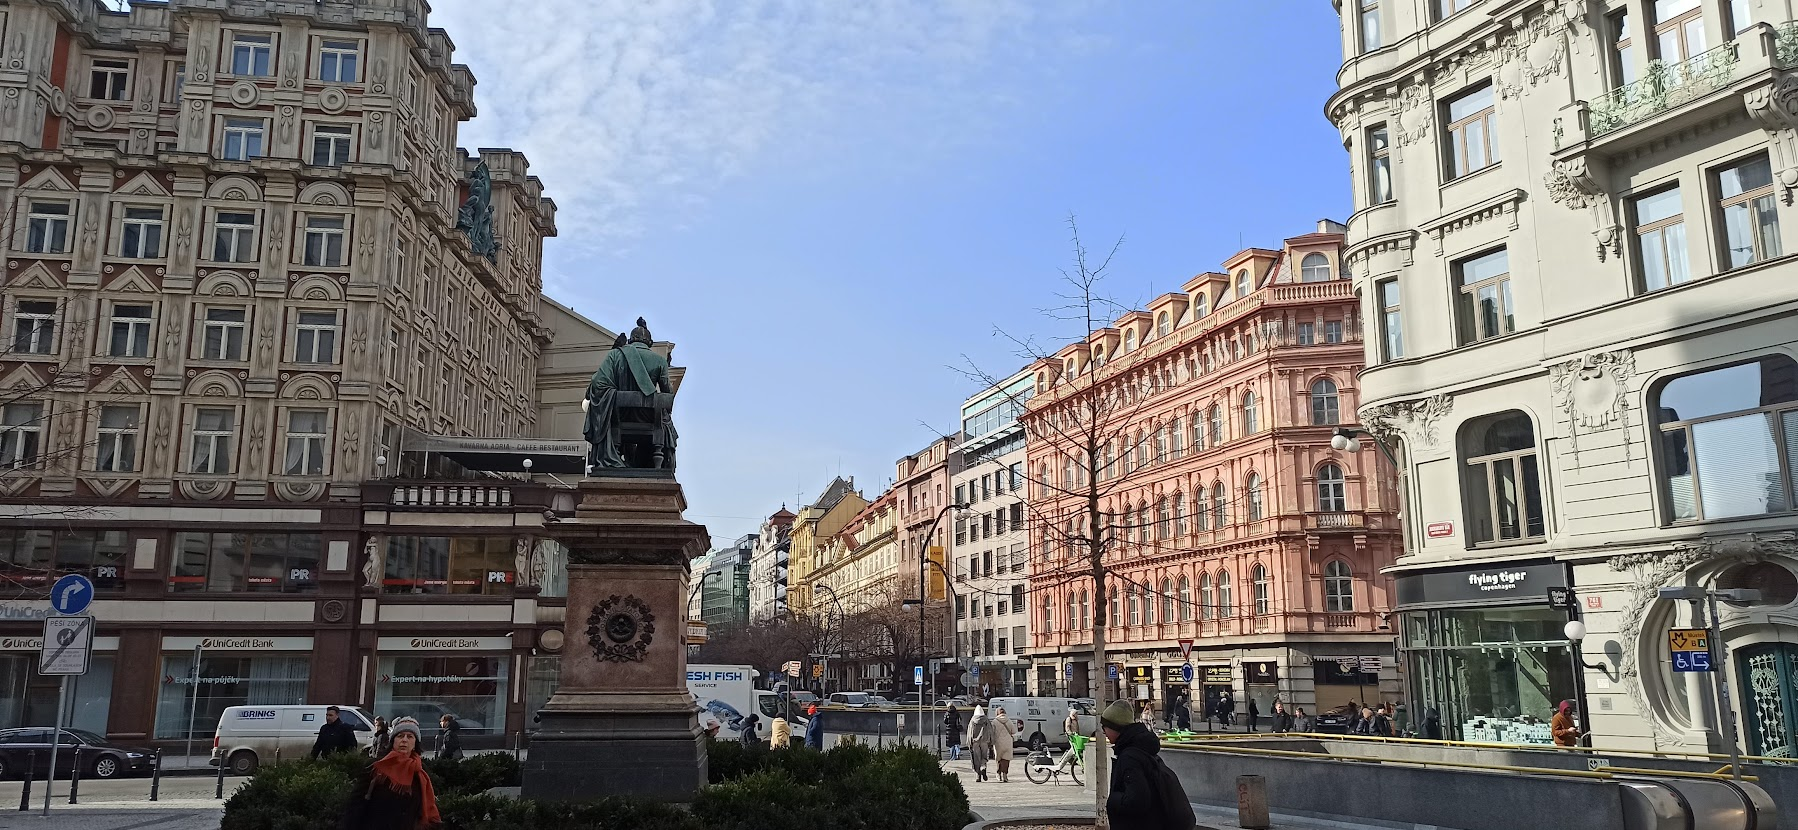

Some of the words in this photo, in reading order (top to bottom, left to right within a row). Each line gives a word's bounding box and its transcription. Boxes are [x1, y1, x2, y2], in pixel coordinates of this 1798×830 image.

[481, 291, 501, 317] ADRIA
[97, 566, 117, 578] PR
[488, 571, 513, 583] PRE
[1468, 573, 1499, 586] flying
[1499, 571, 1526, 584] tiger
[13, 639, 42, 648] UniCre
[213, 639, 250, 648] UniCredit
[252, 639, 274, 648] Bank
[421, 639, 457, 648] UniCredit
[459, 639, 479, 648] Bank
[175, 676, 200, 685] Expet
[214, 676, 240, 685] půjčky
[391, 675, 415, 684] Expert
[428, 674, 463, 684] hypotéky
[687, 672, 711, 680] ESH
[715, 672, 742, 680] FISH
[243, 710, 276, 718] BRINKS
